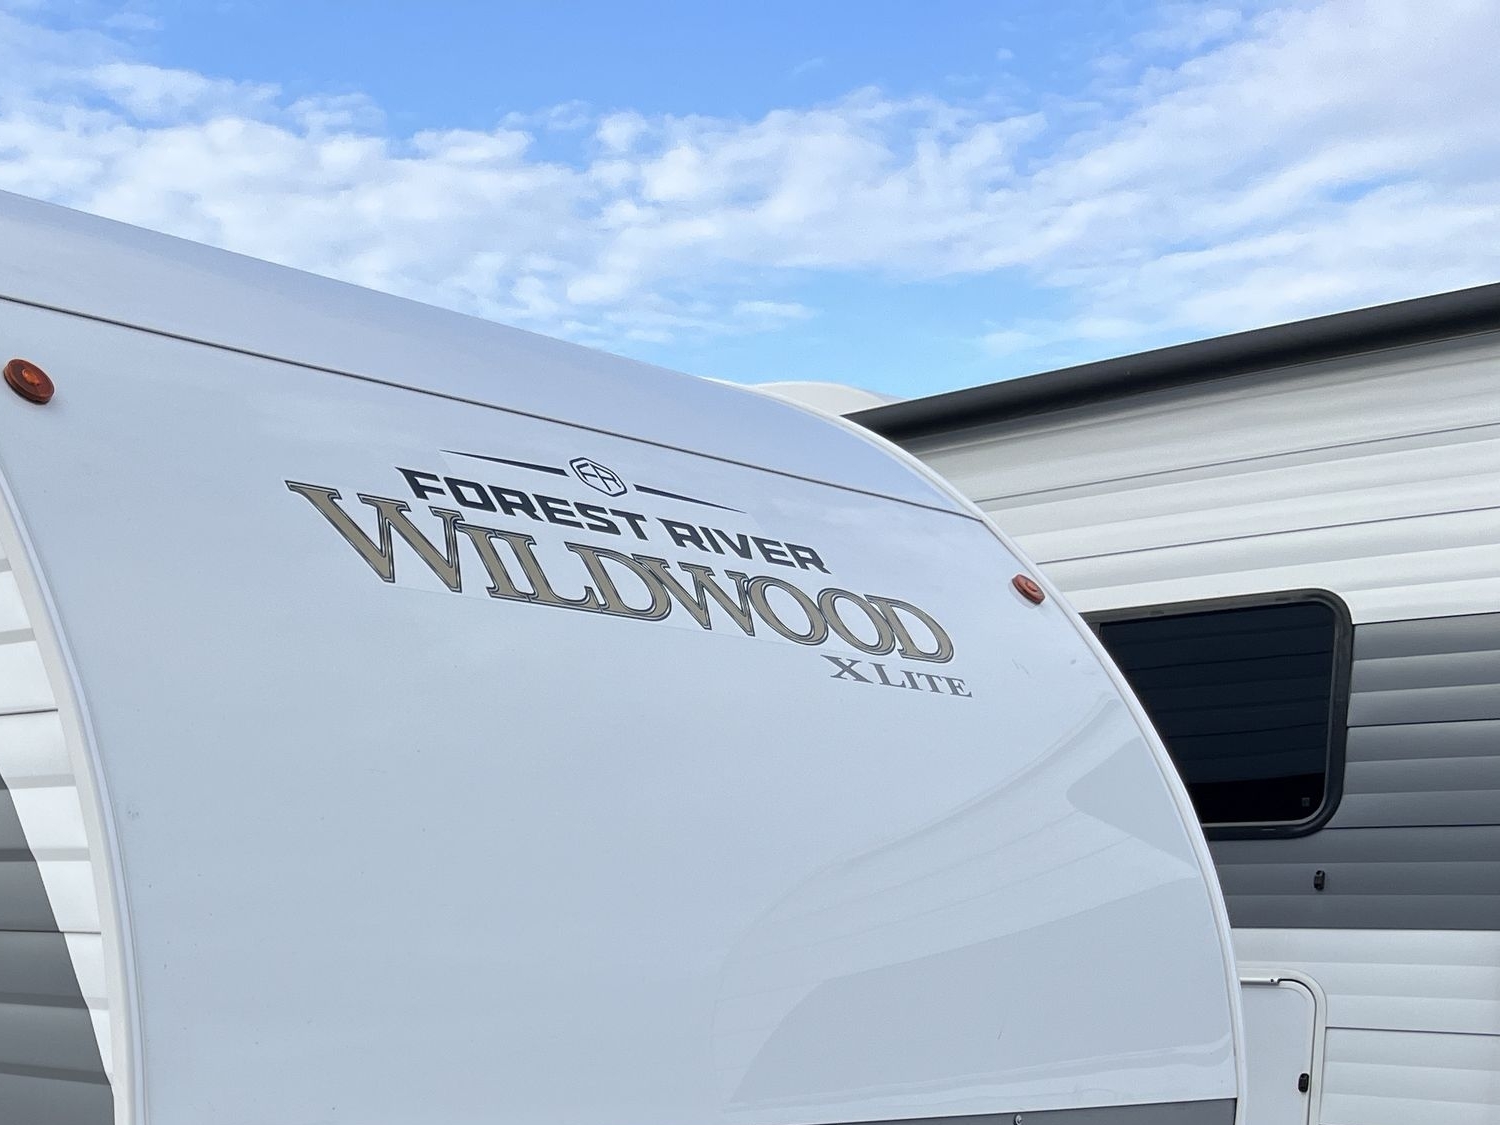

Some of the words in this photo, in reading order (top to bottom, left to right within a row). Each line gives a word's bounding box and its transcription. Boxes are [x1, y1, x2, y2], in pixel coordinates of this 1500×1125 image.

[285, 480, 954, 663] WILDWOOD
[395, 466, 647, 540] FOREST
[656, 518, 832, 574] RIVER
[820, 654, 873, 684] X
[868, 661, 973, 698] LITE
